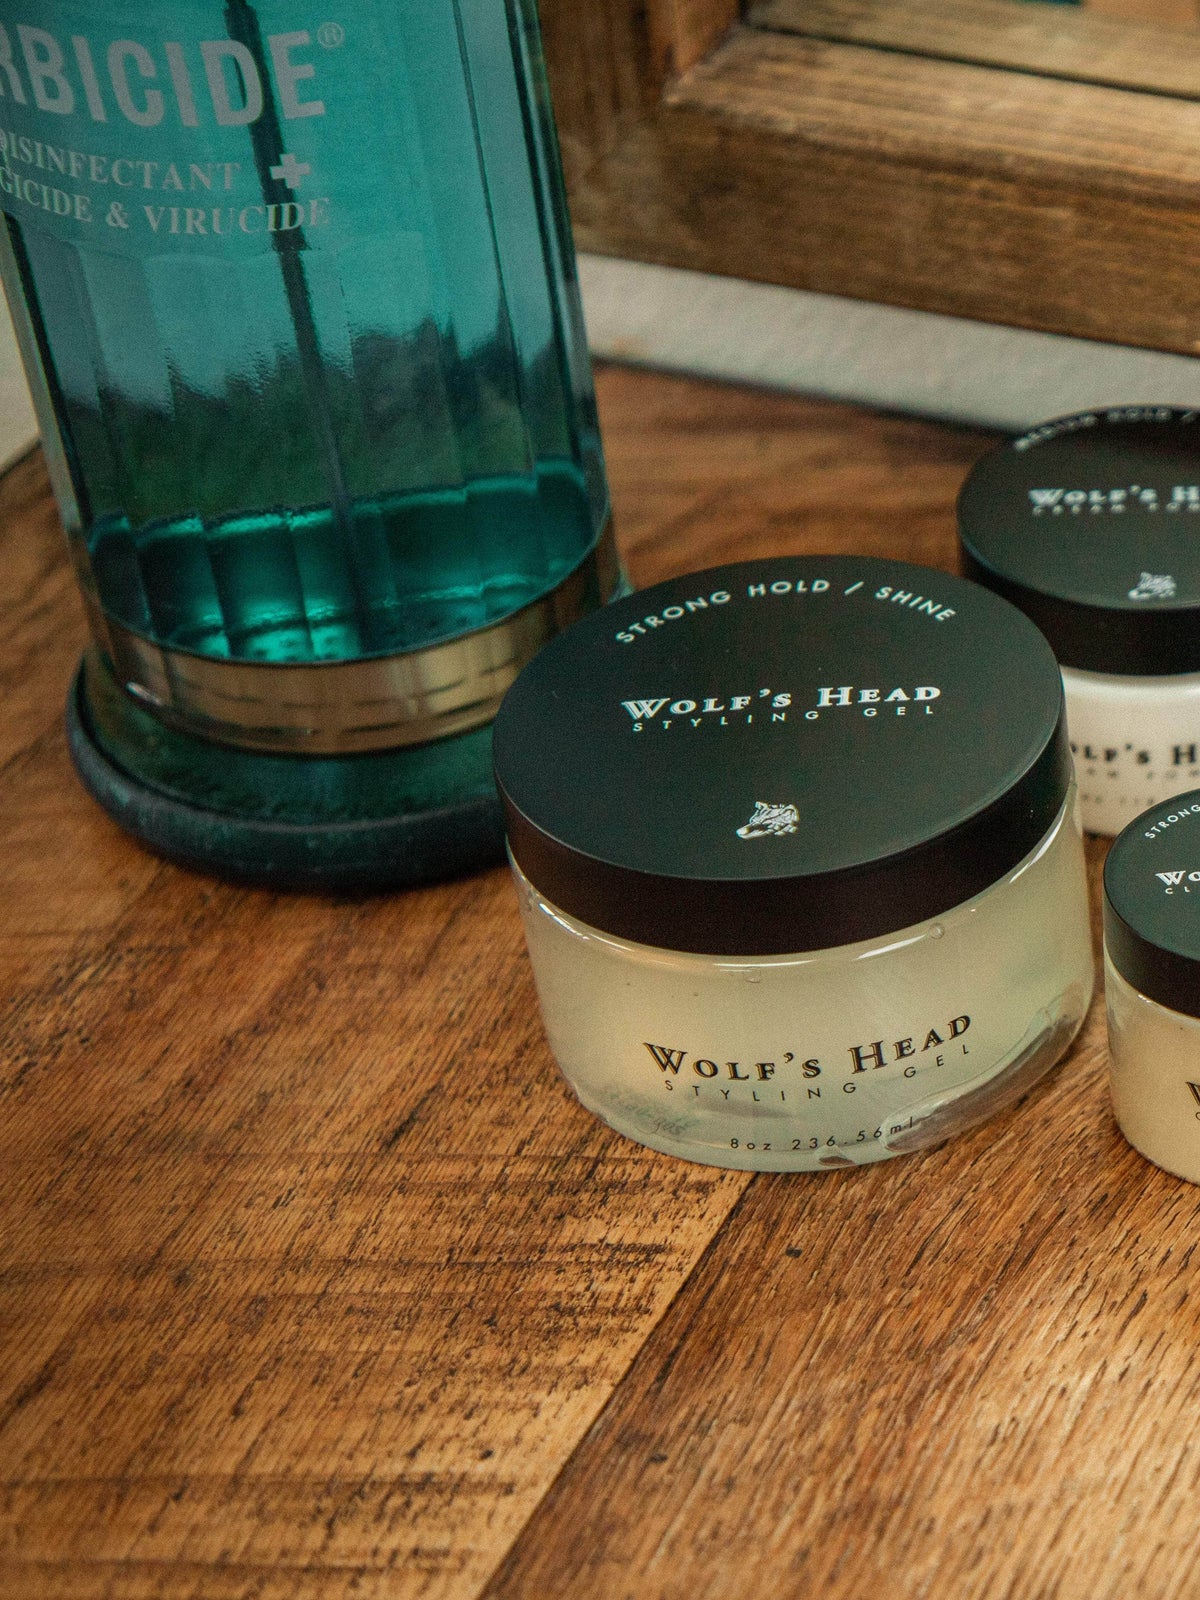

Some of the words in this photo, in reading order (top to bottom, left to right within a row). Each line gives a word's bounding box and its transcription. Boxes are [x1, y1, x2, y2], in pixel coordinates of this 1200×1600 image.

[105, 202, 129, 229] &
[144, 197, 330, 234] VIRUCIDE
[615, 590, 731, 644] STRONG
[747, 579, 831, 598] HOLD
[875, 585, 957, 623] SHINE
[620, 688, 792, 720] WOLF'S
[816, 685, 941, 708] HEAD
[633, 709, 819, 732] STYLING
[863, 705, 934, 717] GEL
[643, 1042, 822, 1082] WOLF'S
[847, 1014, 972, 1075] HEAD
[664, 1079, 857, 1102] STYLING
[903, 1043, 969, 1079] GEL
[729, 1137, 772, 1151] 8oz
